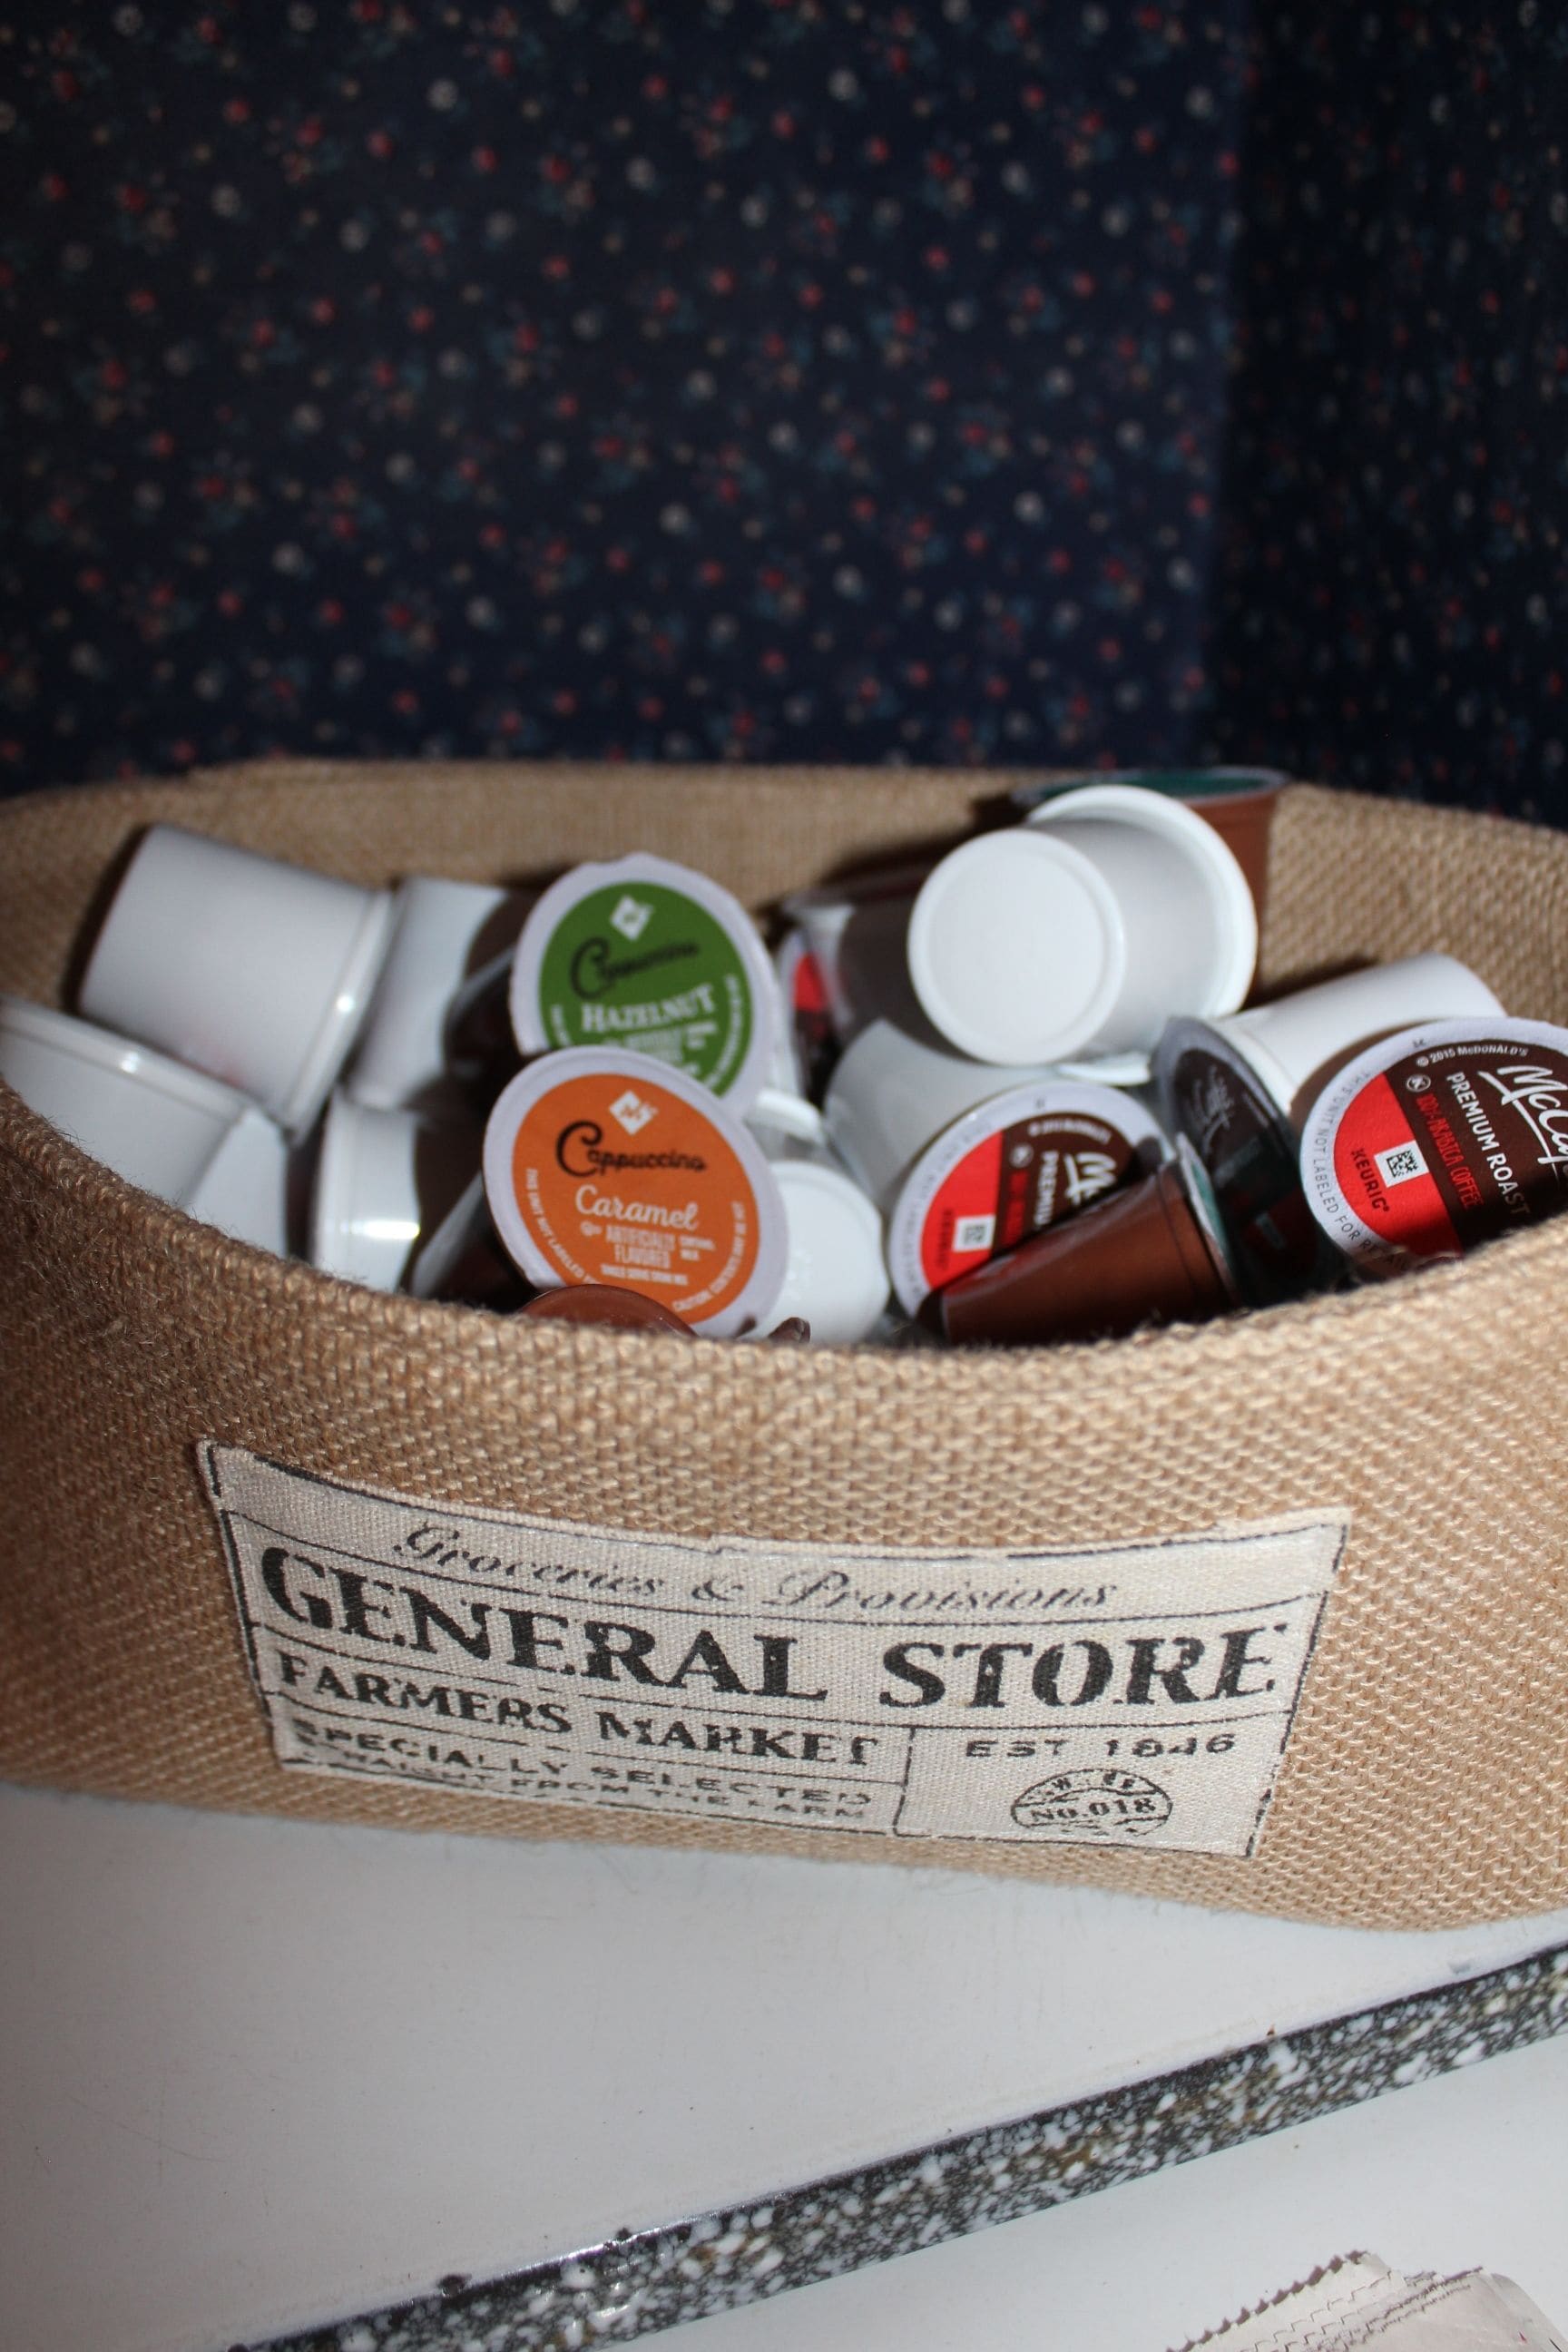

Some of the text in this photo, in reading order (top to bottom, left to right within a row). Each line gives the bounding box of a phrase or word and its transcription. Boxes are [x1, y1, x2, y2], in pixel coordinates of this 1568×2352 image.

[582, 984, 714, 1033] HAZELNUT
[555, 1120, 706, 1177] Cappuccino
[1446, 1072, 1531, 1215] PREMIUM ROAST
[575, 1184, 699, 1230] Caramel
[1312, 1156, 1339, 1214] LABELED
[1335, 1213, 1361, 1241] FOR
[1450, 1166, 1485, 1210] COFFEE
[392, 1519, 1117, 1611] Groceries & Provisions
[261, 1546, 1288, 1708] GENERAL STORE
[276, 1649, 879, 1766] FARMERS MARKET
[965, 1733, 1236, 1758] EST 1846
[291, 1718, 871, 1805] SPECIALLY SELECTED
